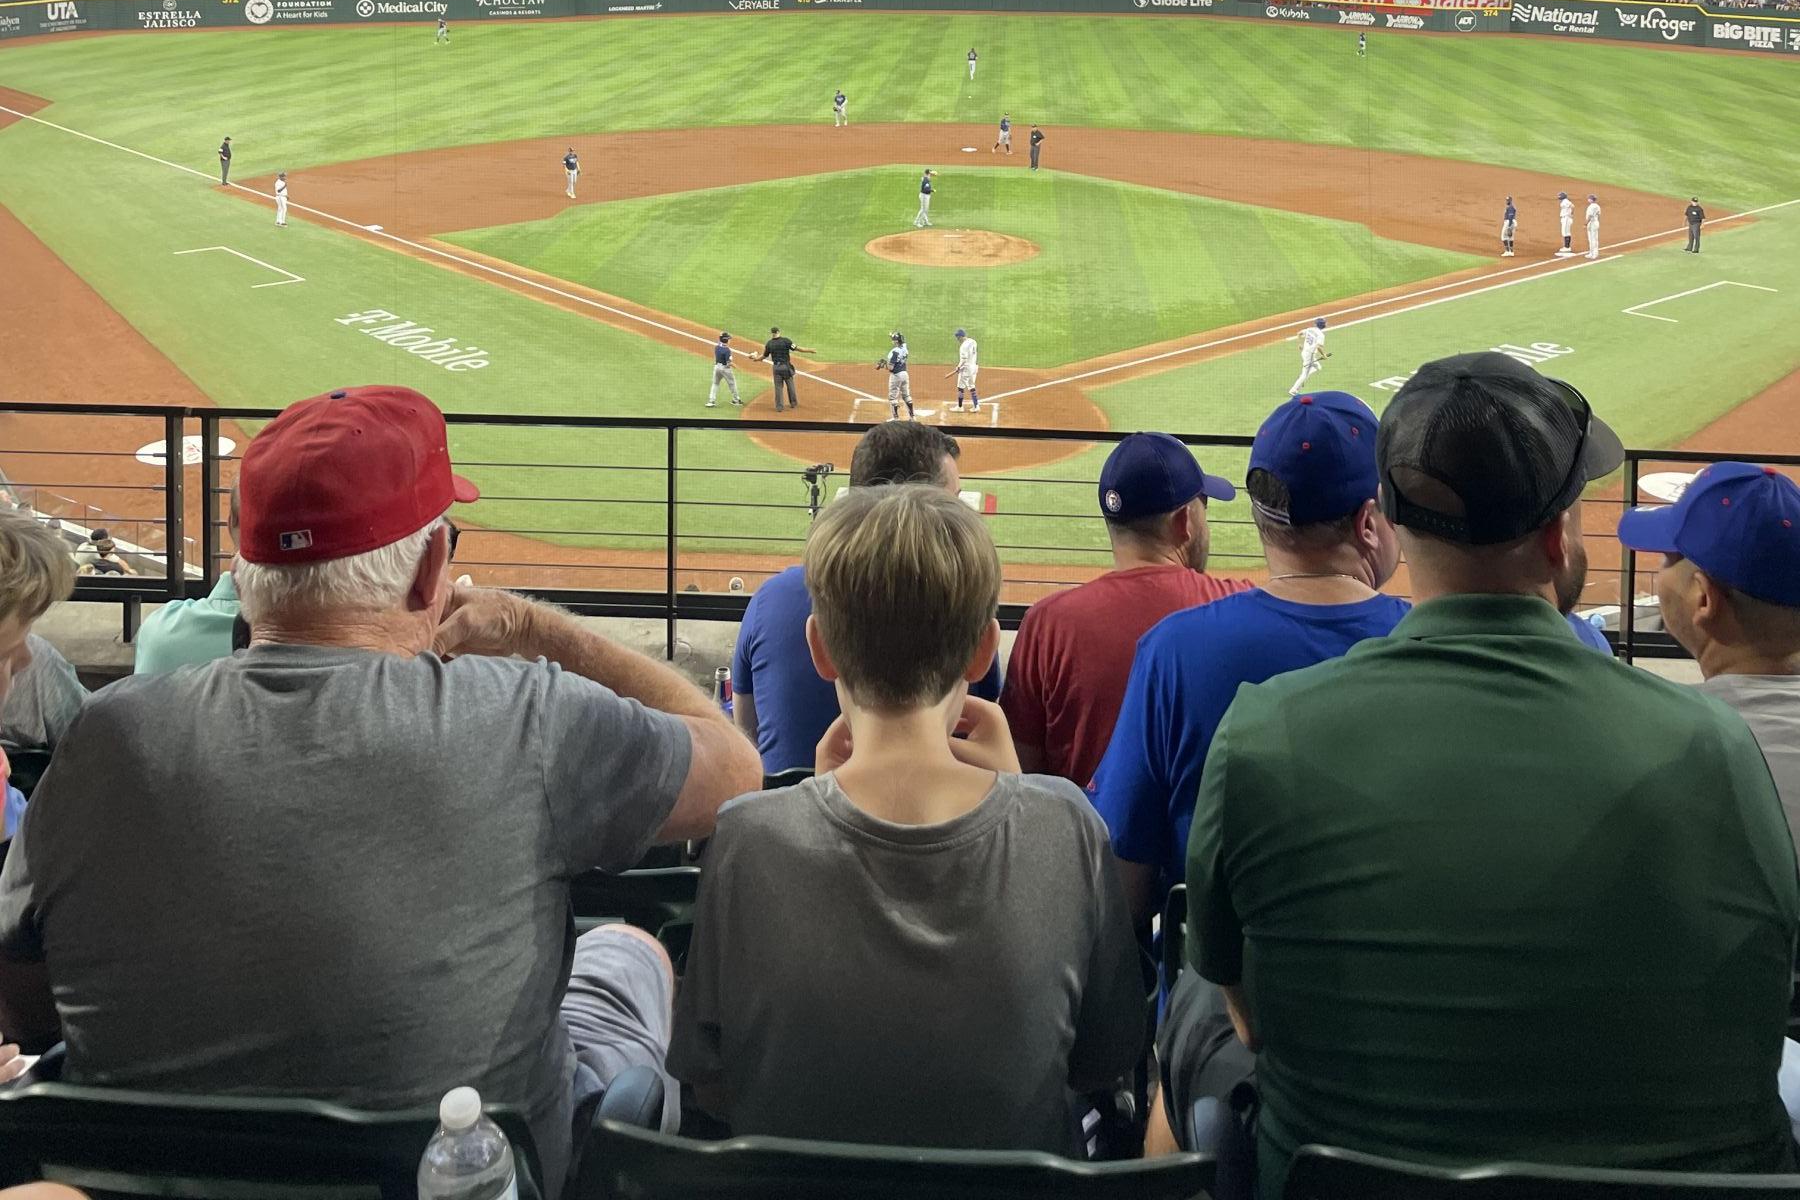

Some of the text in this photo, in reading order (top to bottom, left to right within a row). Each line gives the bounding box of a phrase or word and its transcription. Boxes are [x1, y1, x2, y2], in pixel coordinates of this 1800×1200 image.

[47, 1, 78, 20] UTA
[377, 2, 448, 15] Medical City
[1280, 8, 1310, 19] Kubota
[1483, 9, 1498, 17] 374
[138, 10, 201, 20] ESTRELLA
[143, 18, 195, 28] JALISCO
[1458, 16, 1474, 25] ADT
[1640, 8, 1696, 40] Kroger
[1554, 24, 1595, 34] Car Rental
[1744, 25, 1782, 42] BITE
[1749, 40, 1774, 48] PIZZA
